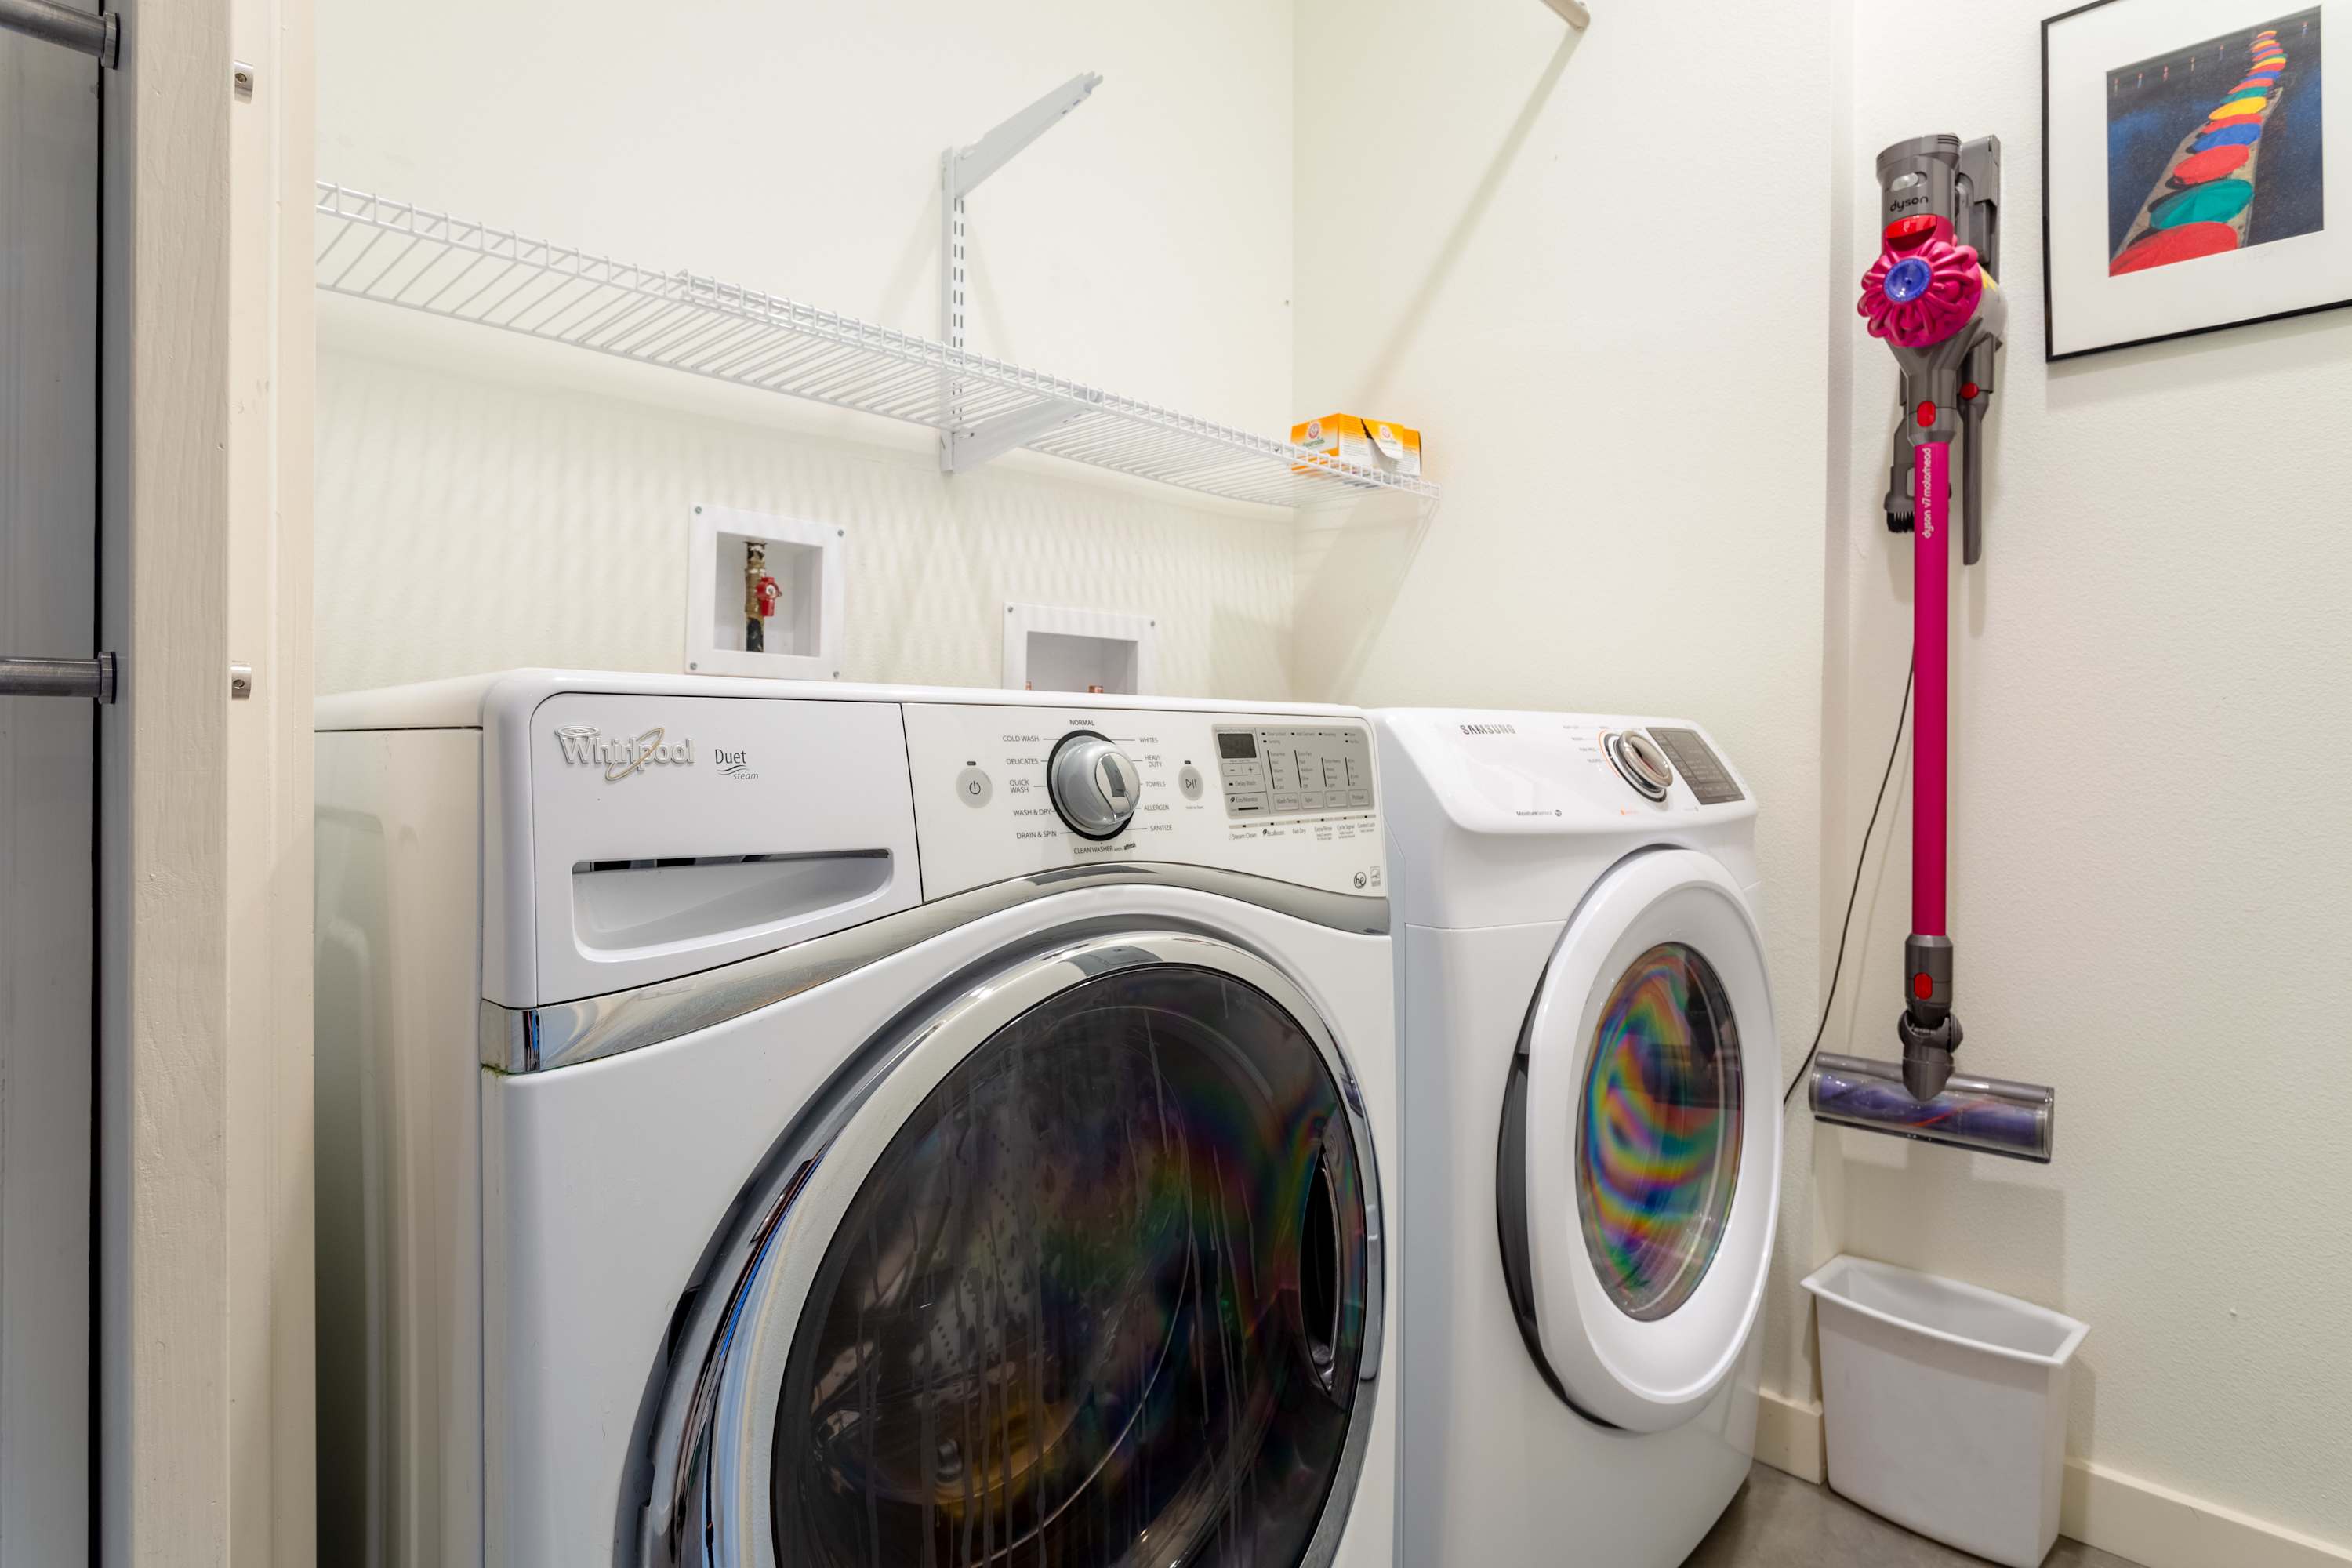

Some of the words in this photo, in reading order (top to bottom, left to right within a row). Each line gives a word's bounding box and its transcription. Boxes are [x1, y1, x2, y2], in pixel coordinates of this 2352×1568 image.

[1890, 195, 1929, 212] dyson
[1922, 448, 1931, 497] motorhead
[1922, 510, 1934, 539] dyson
[1460, 724, 1516, 735] SAMSUNG
[558, 732, 696, 773] Whirlpool
[715, 749, 746, 764] Duet
[1074, 846, 1091, 855] CLEAN
